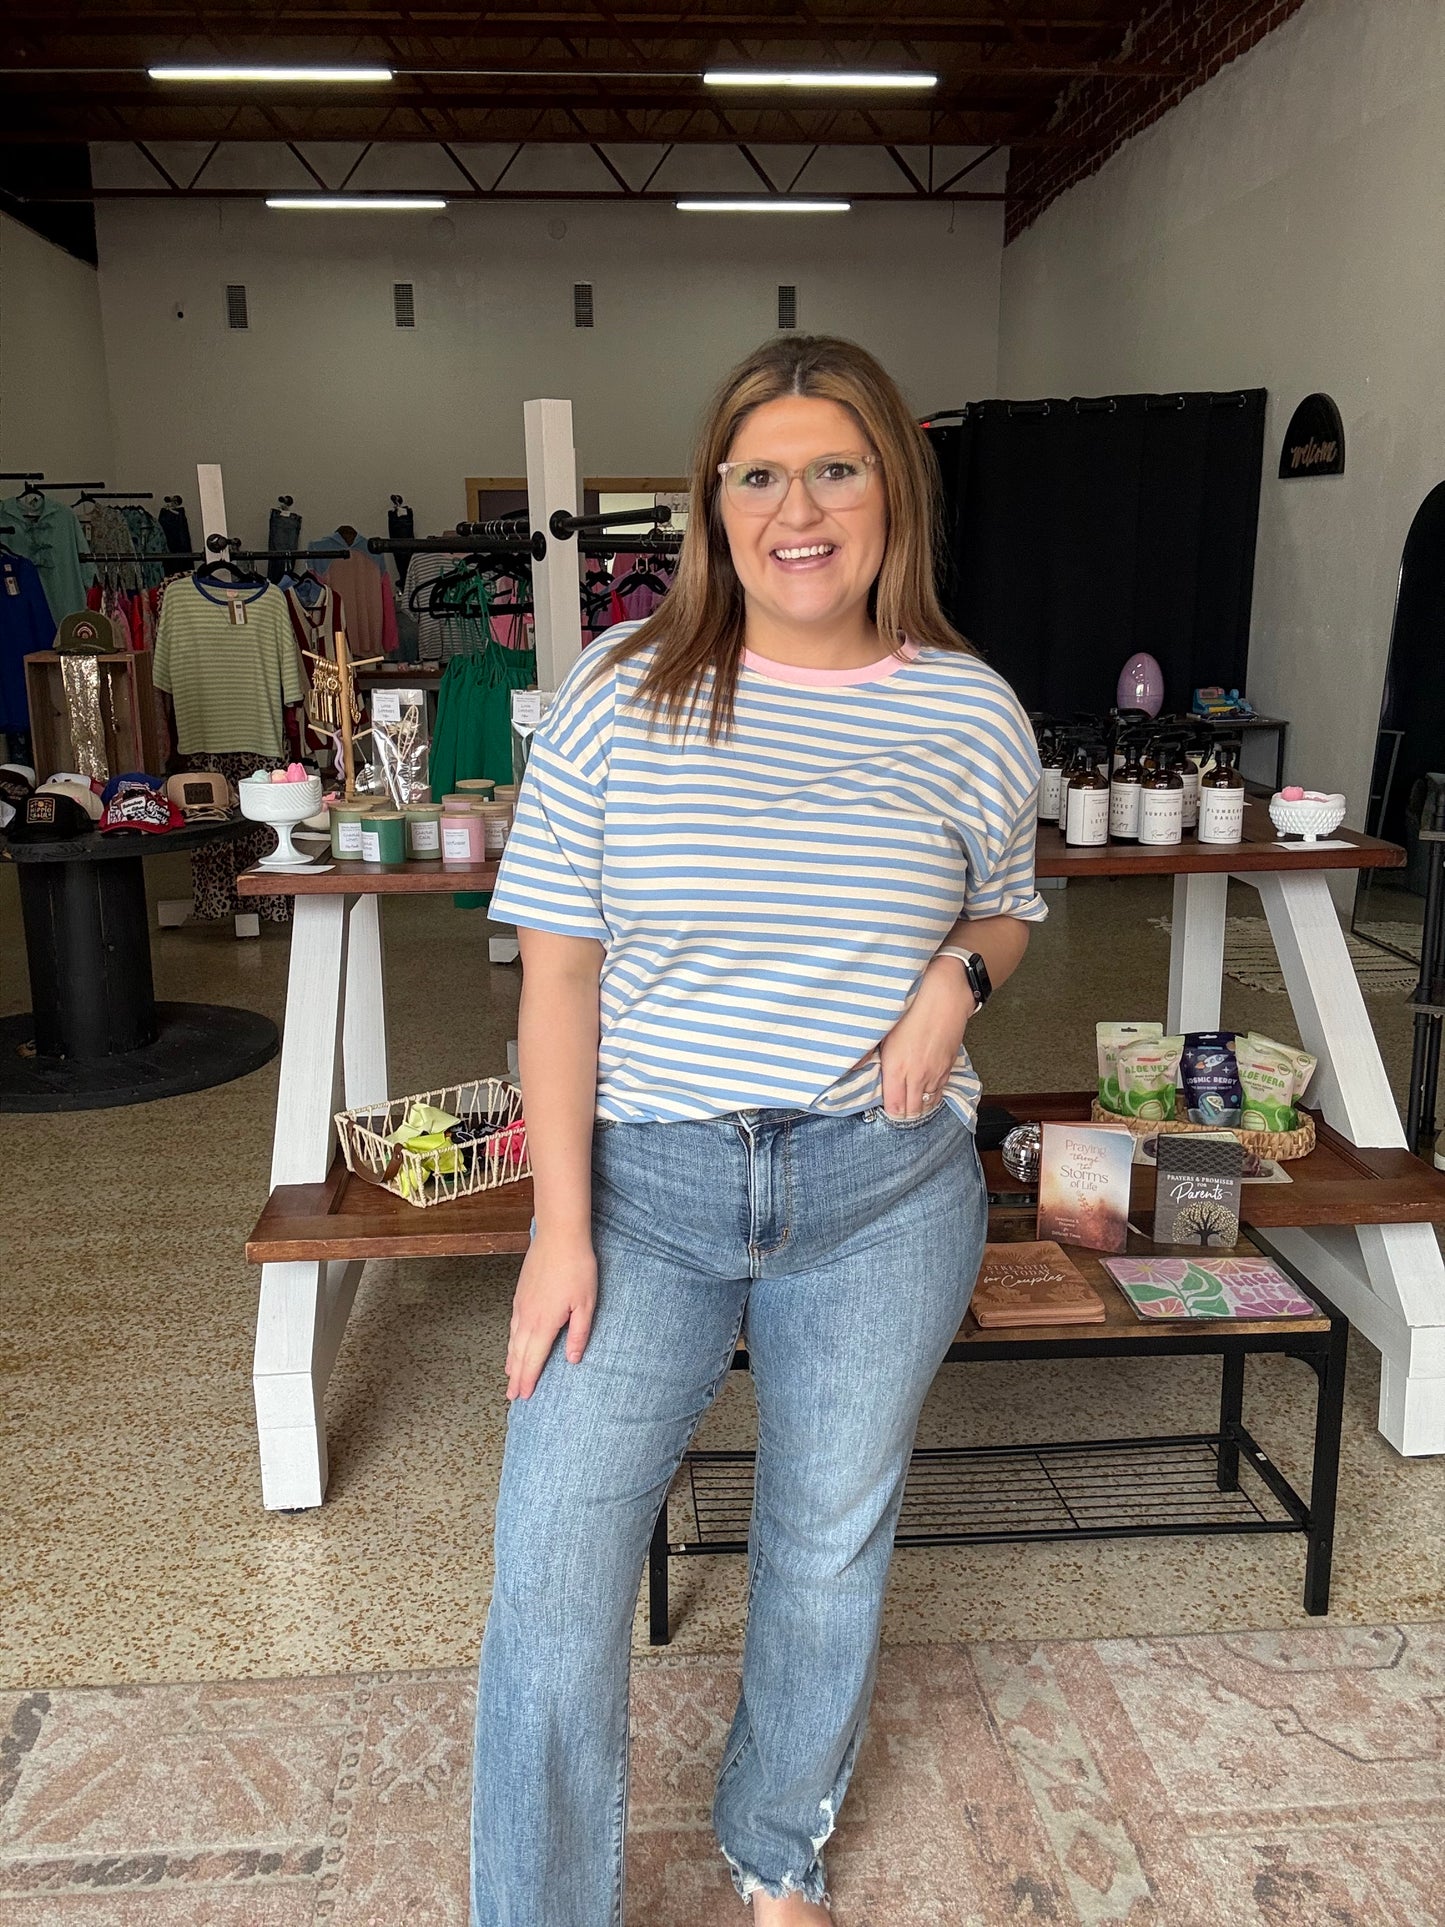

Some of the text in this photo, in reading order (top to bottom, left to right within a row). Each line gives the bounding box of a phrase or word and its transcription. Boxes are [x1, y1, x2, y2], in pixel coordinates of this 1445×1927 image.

[1124, 1064, 1148, 1074] ALOE
[1186, 1076, 1211, 1085] COSMIC
[1213, 1076, 1238, 1086] BERRY
[1261, 1074, 1285, 1089] VERA
[1065, 1139, 1107, 1159] Praying
[1060, 1164, 1109, 1184] Storms
[1166, 1174, 1194, 1182] PRAYERS
[1201, 1177, 1234, 1186] PROMISES
[1070, 1180, 1098, 1192] of Life
[1169, 1181, 1233, 1204] Parents
[985, 1263, 1049, 1271] STRENGTH
[983, 1273, 1066, 1288] for Couples
